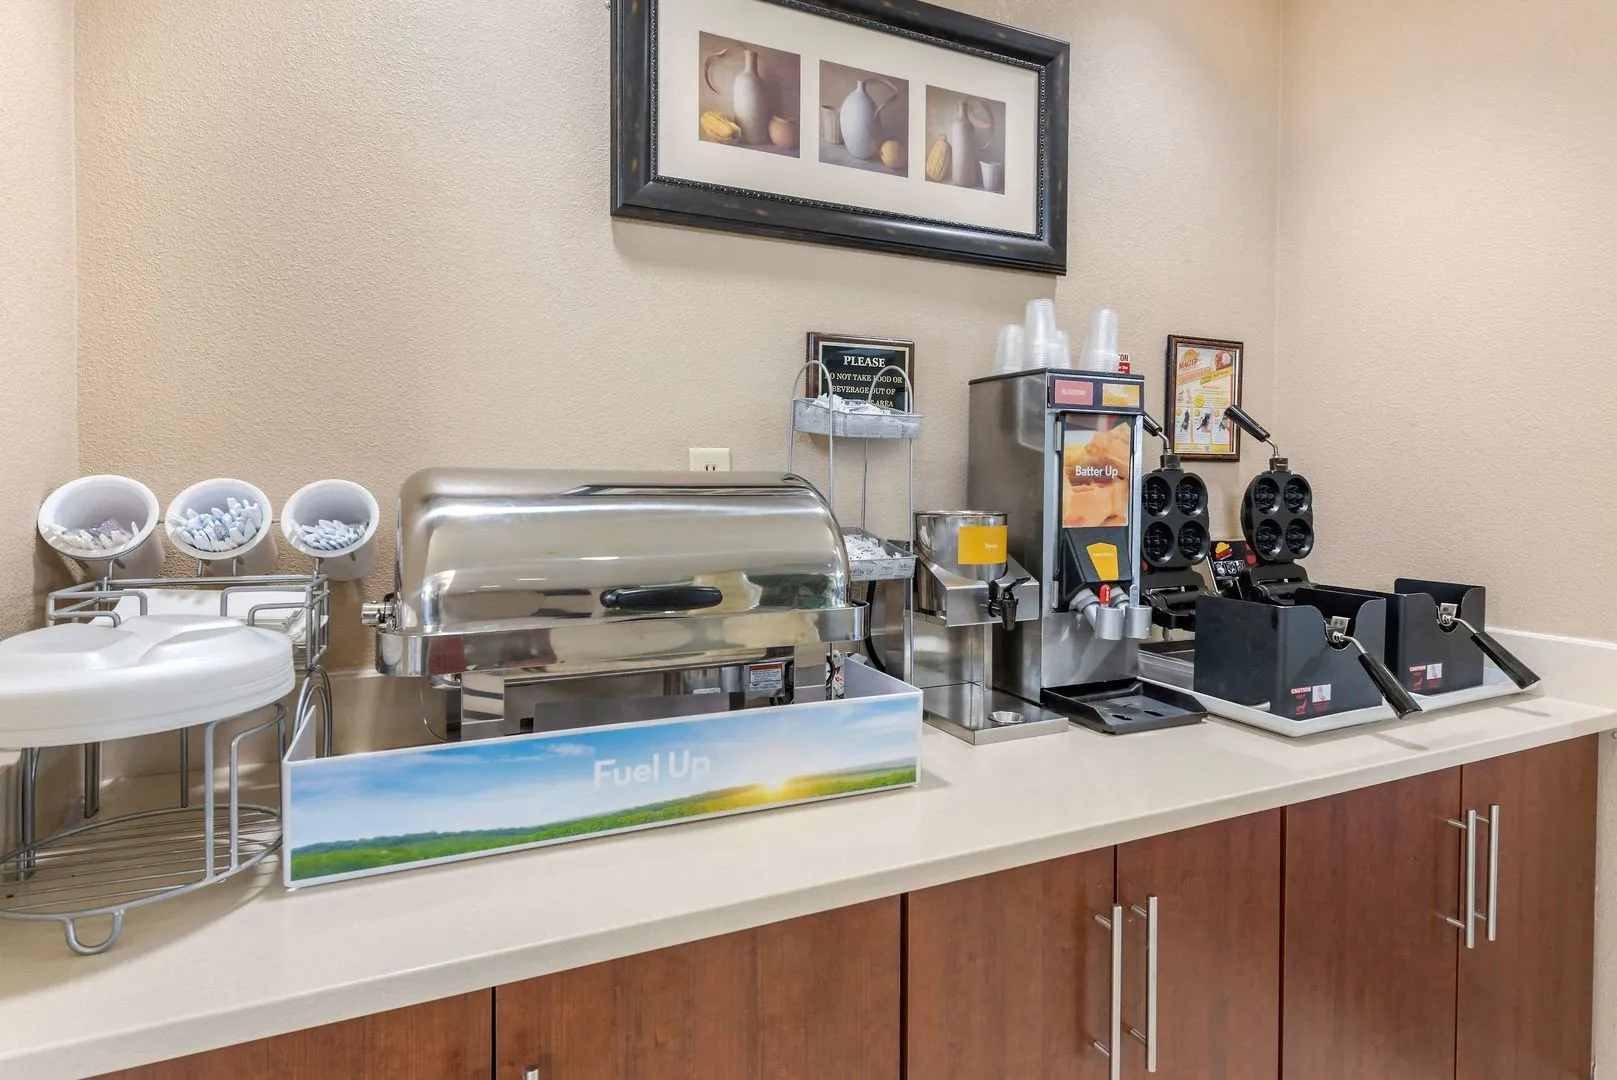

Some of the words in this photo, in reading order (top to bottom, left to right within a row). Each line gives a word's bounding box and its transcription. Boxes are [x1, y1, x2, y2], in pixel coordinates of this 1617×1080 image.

[843, 355, 886, 368] PLEASE
[836, 373, 852, 381] NOT
[851, 374, 872, 382] TAKE
[892, 376, 903, 384] OR
[832, 385, 870, 394] BEVERAGE
[886, 388, 896, 396] OF
[1075, 465, 1104, 477] Batter
[1104, 465, 1119, 479] Up
[1290, 686, 1312, 695] CAUTION
[594, 752, 660, 789] Fuel
[668, 749, 711, 782] Up
